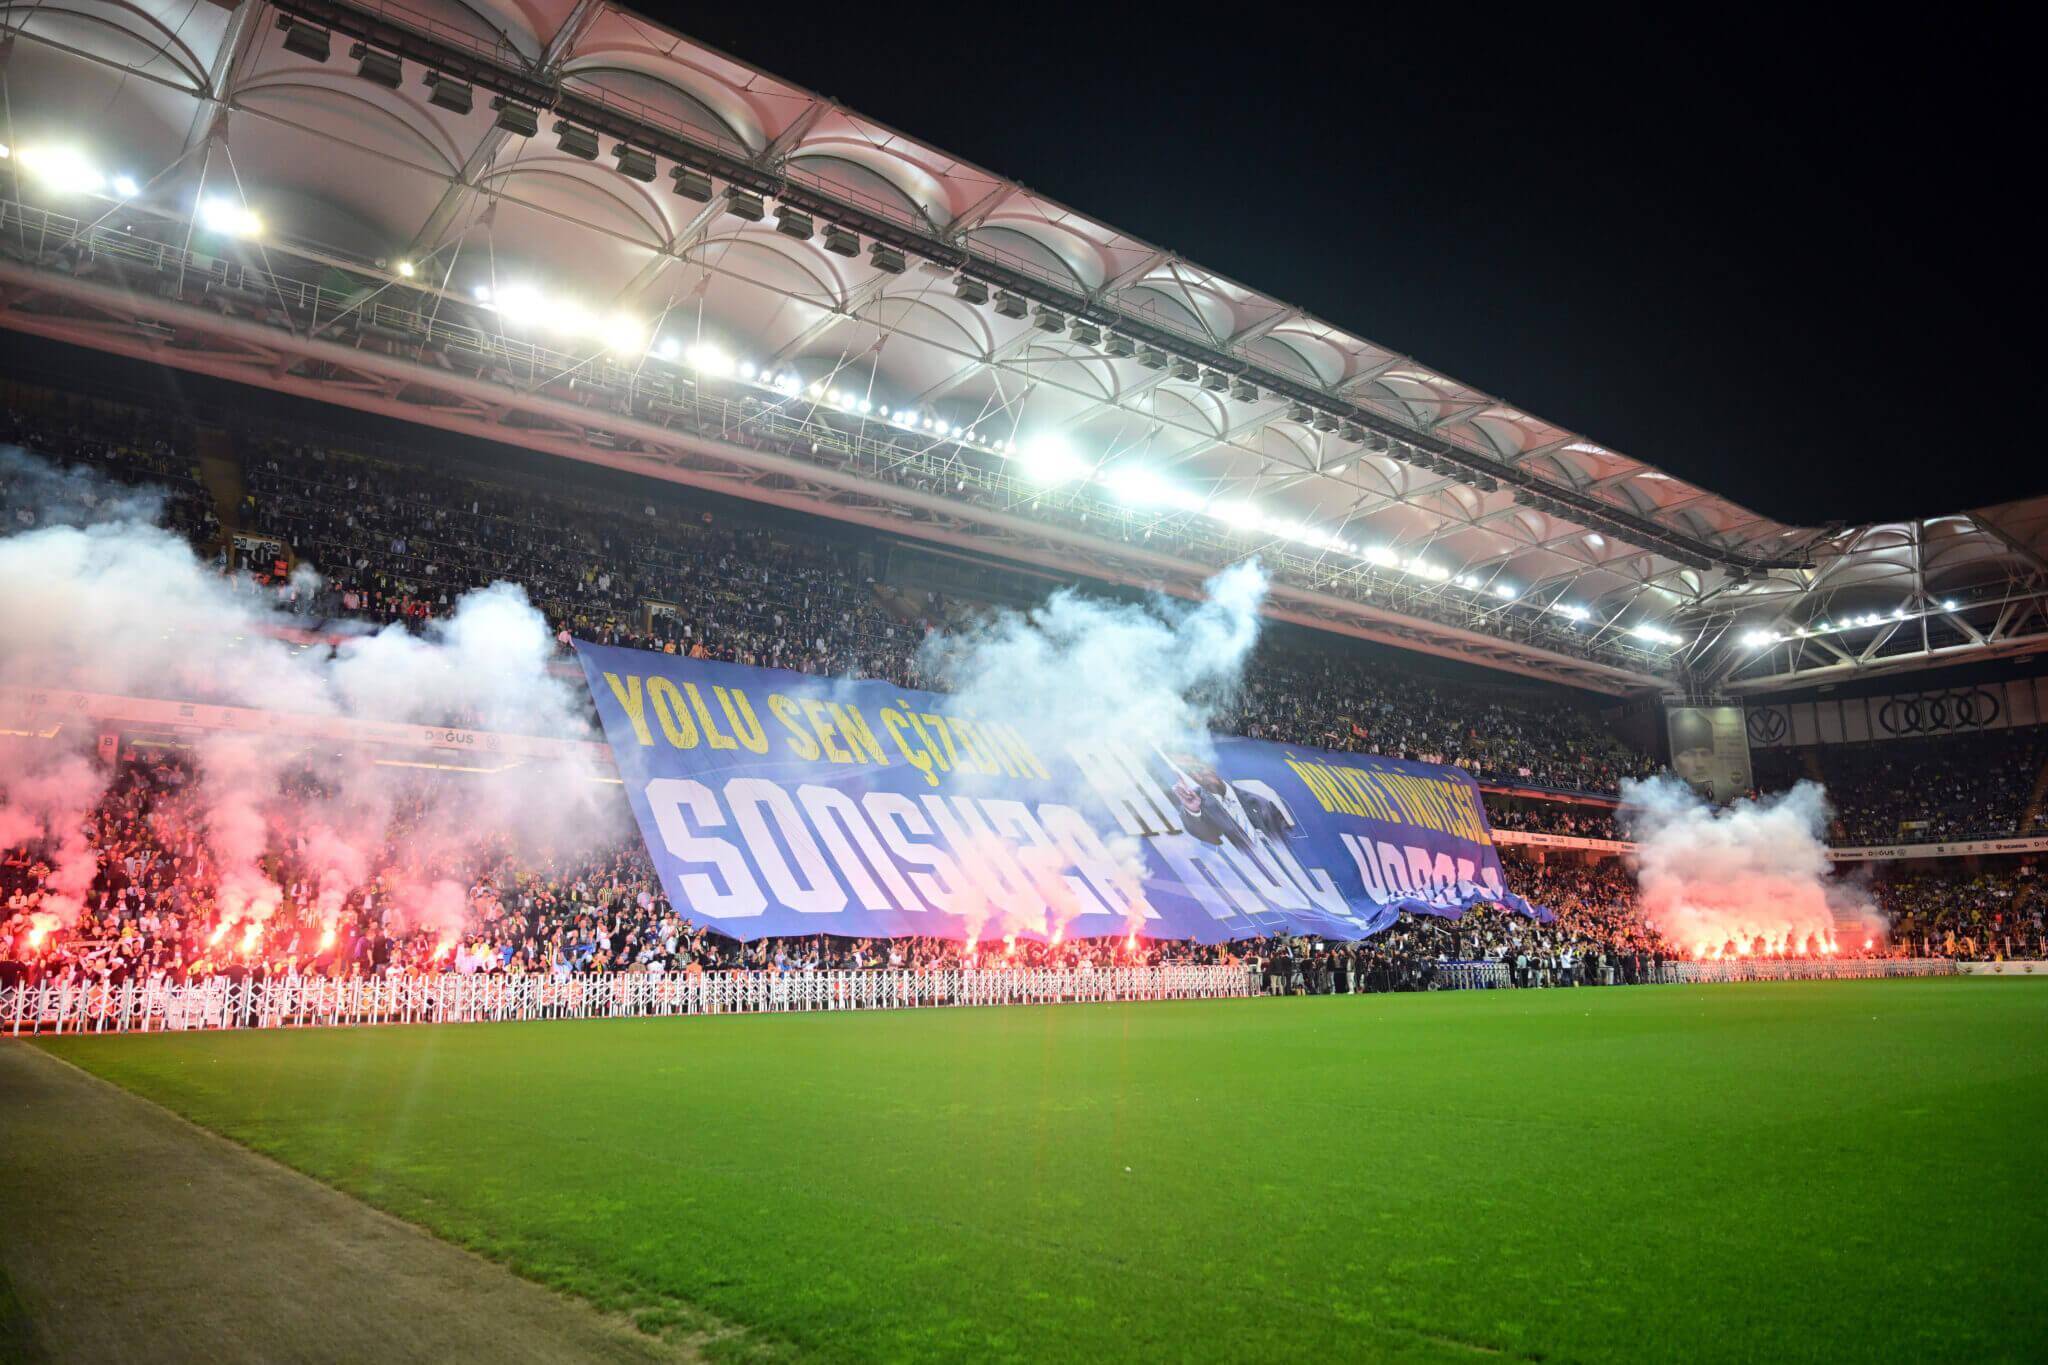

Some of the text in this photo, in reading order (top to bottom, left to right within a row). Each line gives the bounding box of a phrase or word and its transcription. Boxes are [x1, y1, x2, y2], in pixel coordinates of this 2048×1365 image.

[603, 672, 1052, 787] YOLU SEN ÇİZDİN
[1284, 751, 1400, 823] BİRLİKTE
[644, 777, 1163, 919] SONSUZA
